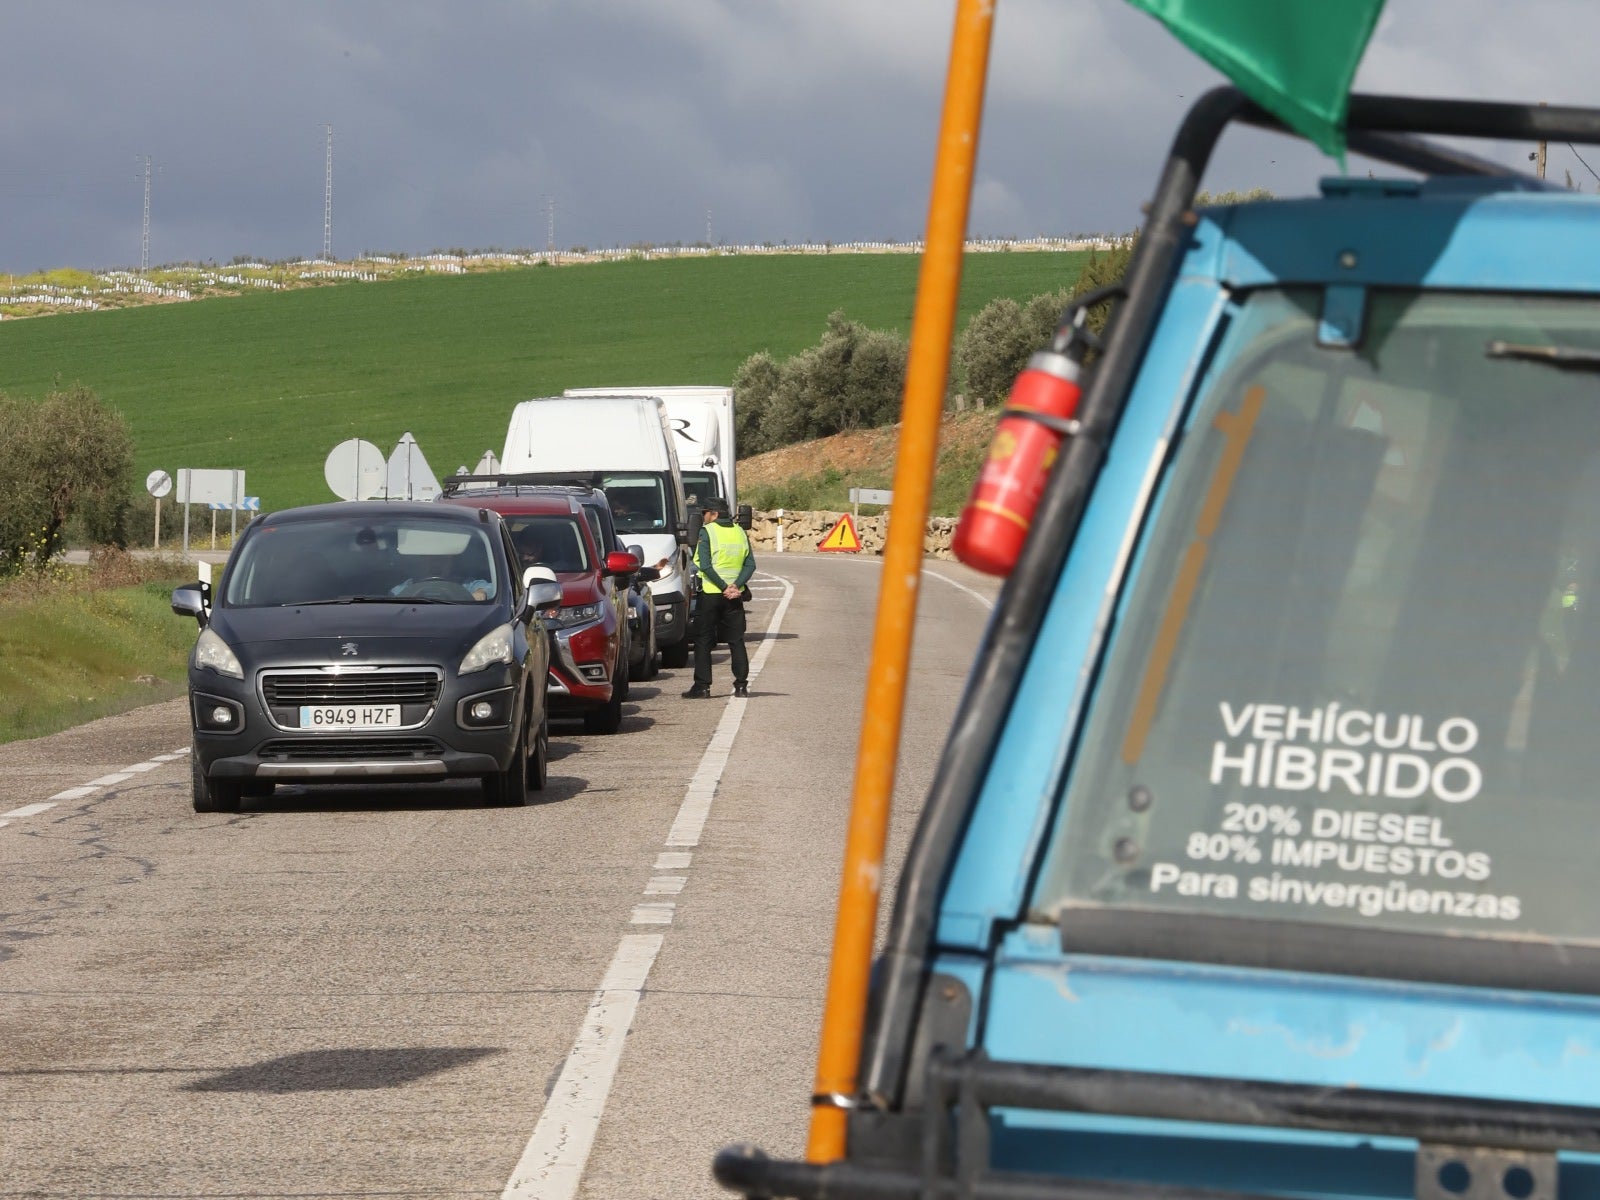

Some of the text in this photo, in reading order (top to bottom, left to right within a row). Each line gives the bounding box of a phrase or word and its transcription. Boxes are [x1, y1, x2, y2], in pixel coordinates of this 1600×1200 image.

[313, 708, 395, 725] 6949 HZF
[1218, 701, 1479, 753] VEHÍCULO
[1209, 740, 1482, 802] HÍBRIDO
[1221, 802, 1453, 846] 20% DIESEL
[1186, 832, 1491, 881] 80% IMPUESTOS
[1150, 863, 1521, 920] Para sinvergüenzas
